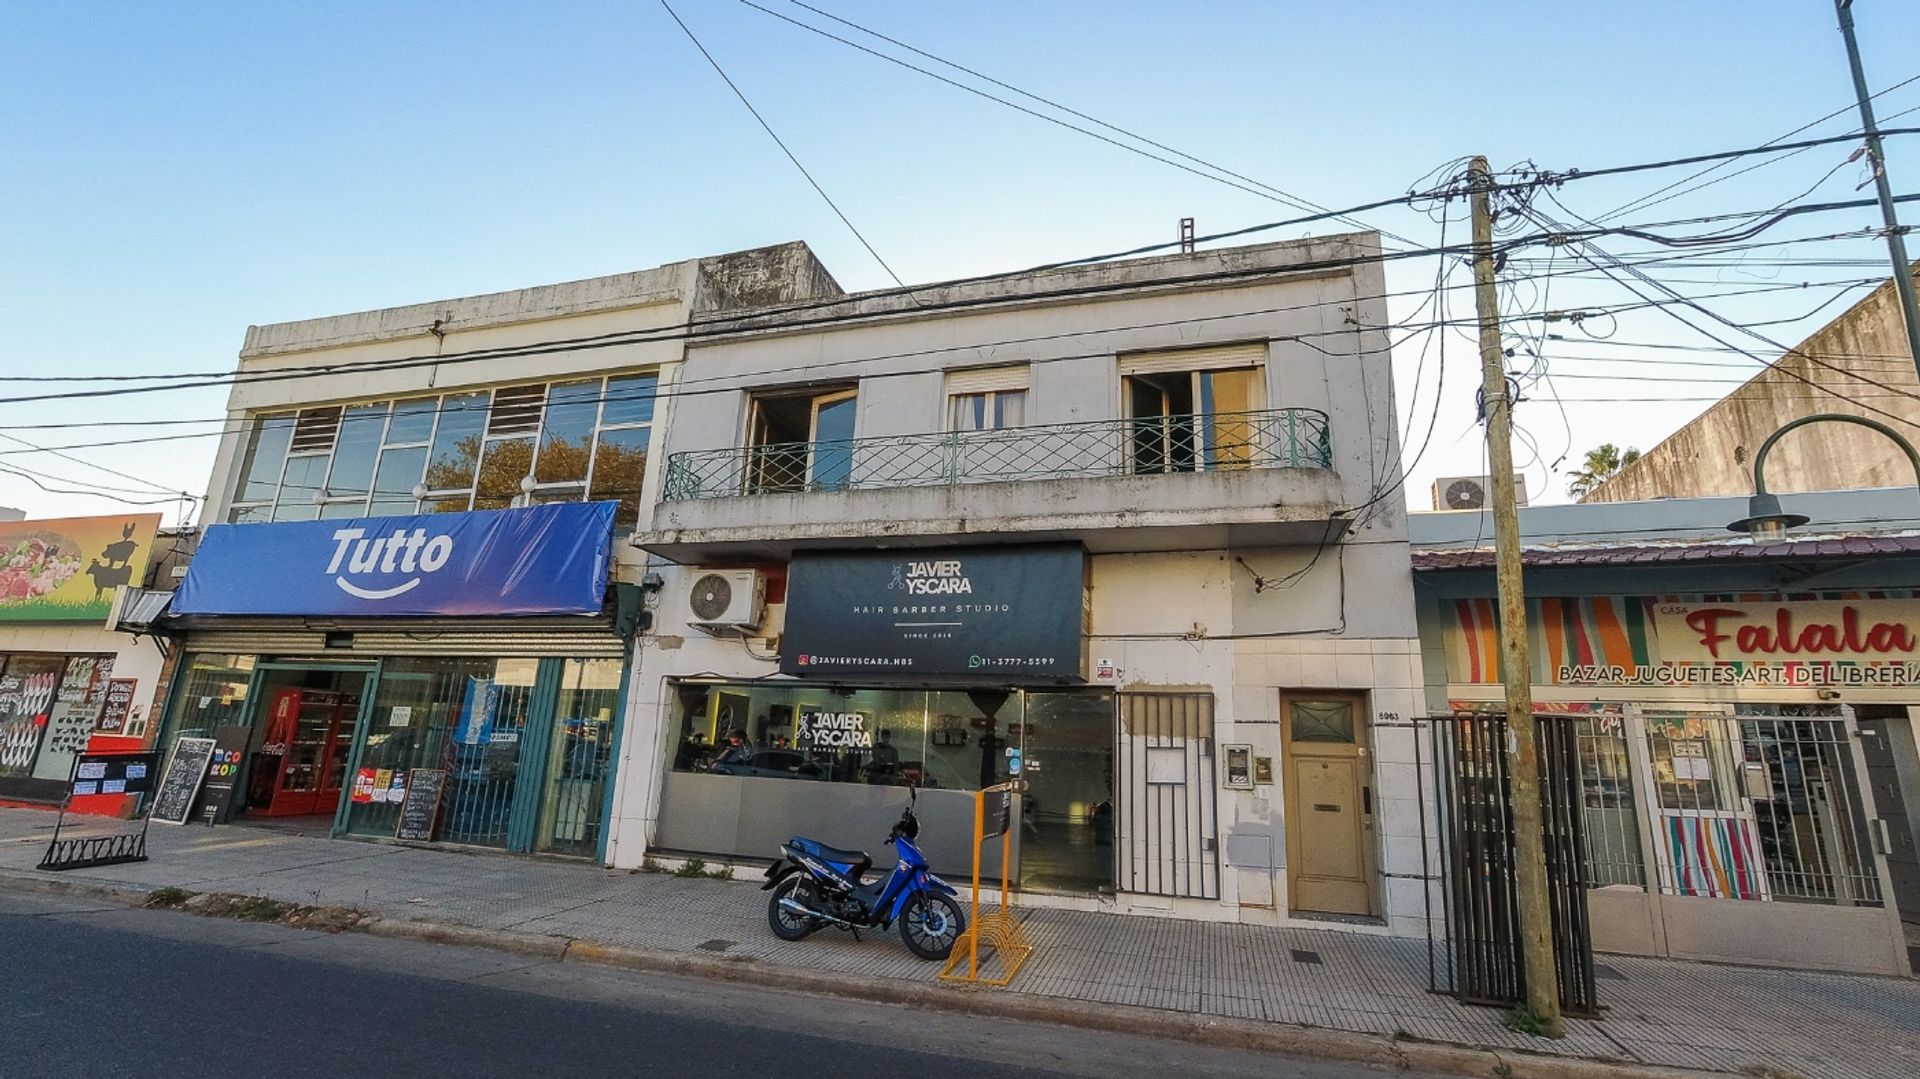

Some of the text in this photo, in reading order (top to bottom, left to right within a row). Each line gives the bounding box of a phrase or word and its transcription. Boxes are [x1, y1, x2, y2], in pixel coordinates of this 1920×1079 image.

[325, 528, 453, 574] Tutto
[906, 561, 962, 577] JAVIER
[905, 577, 973, 595] YSCARA
[853, 603, 1010, 614] HAIR BARBER STUDIO
[1660, 606, 1689, 615] CASA
[1685, 606, 1916, 660] Falala
[1796, 667, 1823, 683] DE
[812, 712, 864, 730] JAVIER
[811, 729, 873, 748] YSCARA
